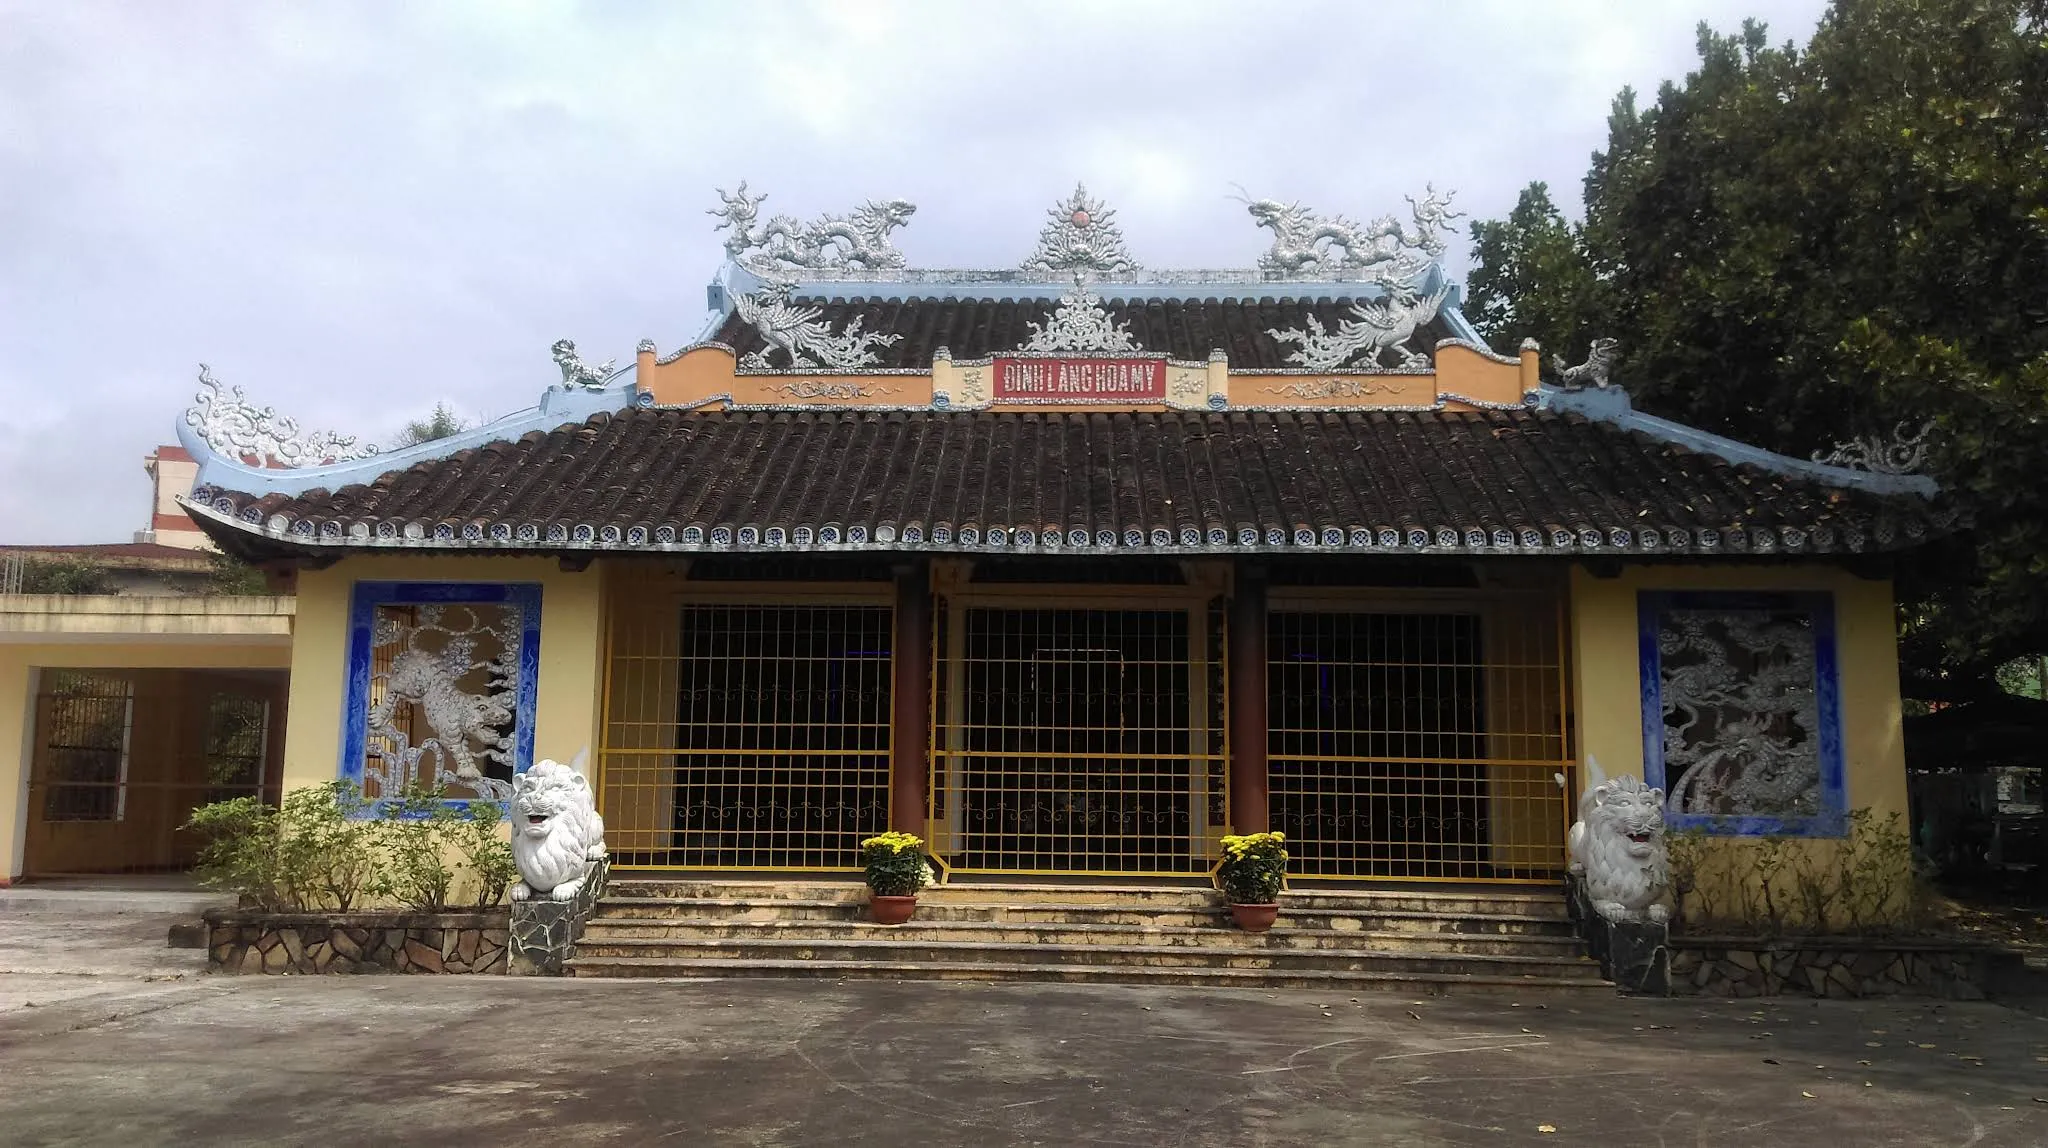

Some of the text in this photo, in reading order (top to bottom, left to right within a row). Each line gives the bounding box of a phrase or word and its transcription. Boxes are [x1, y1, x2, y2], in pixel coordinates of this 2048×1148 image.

[1003, 359, 1044, 392] ĐÌNH
[1047, 360, 1092, 392] LÀNG
[1130, 360, 1159, 393] MỸ
